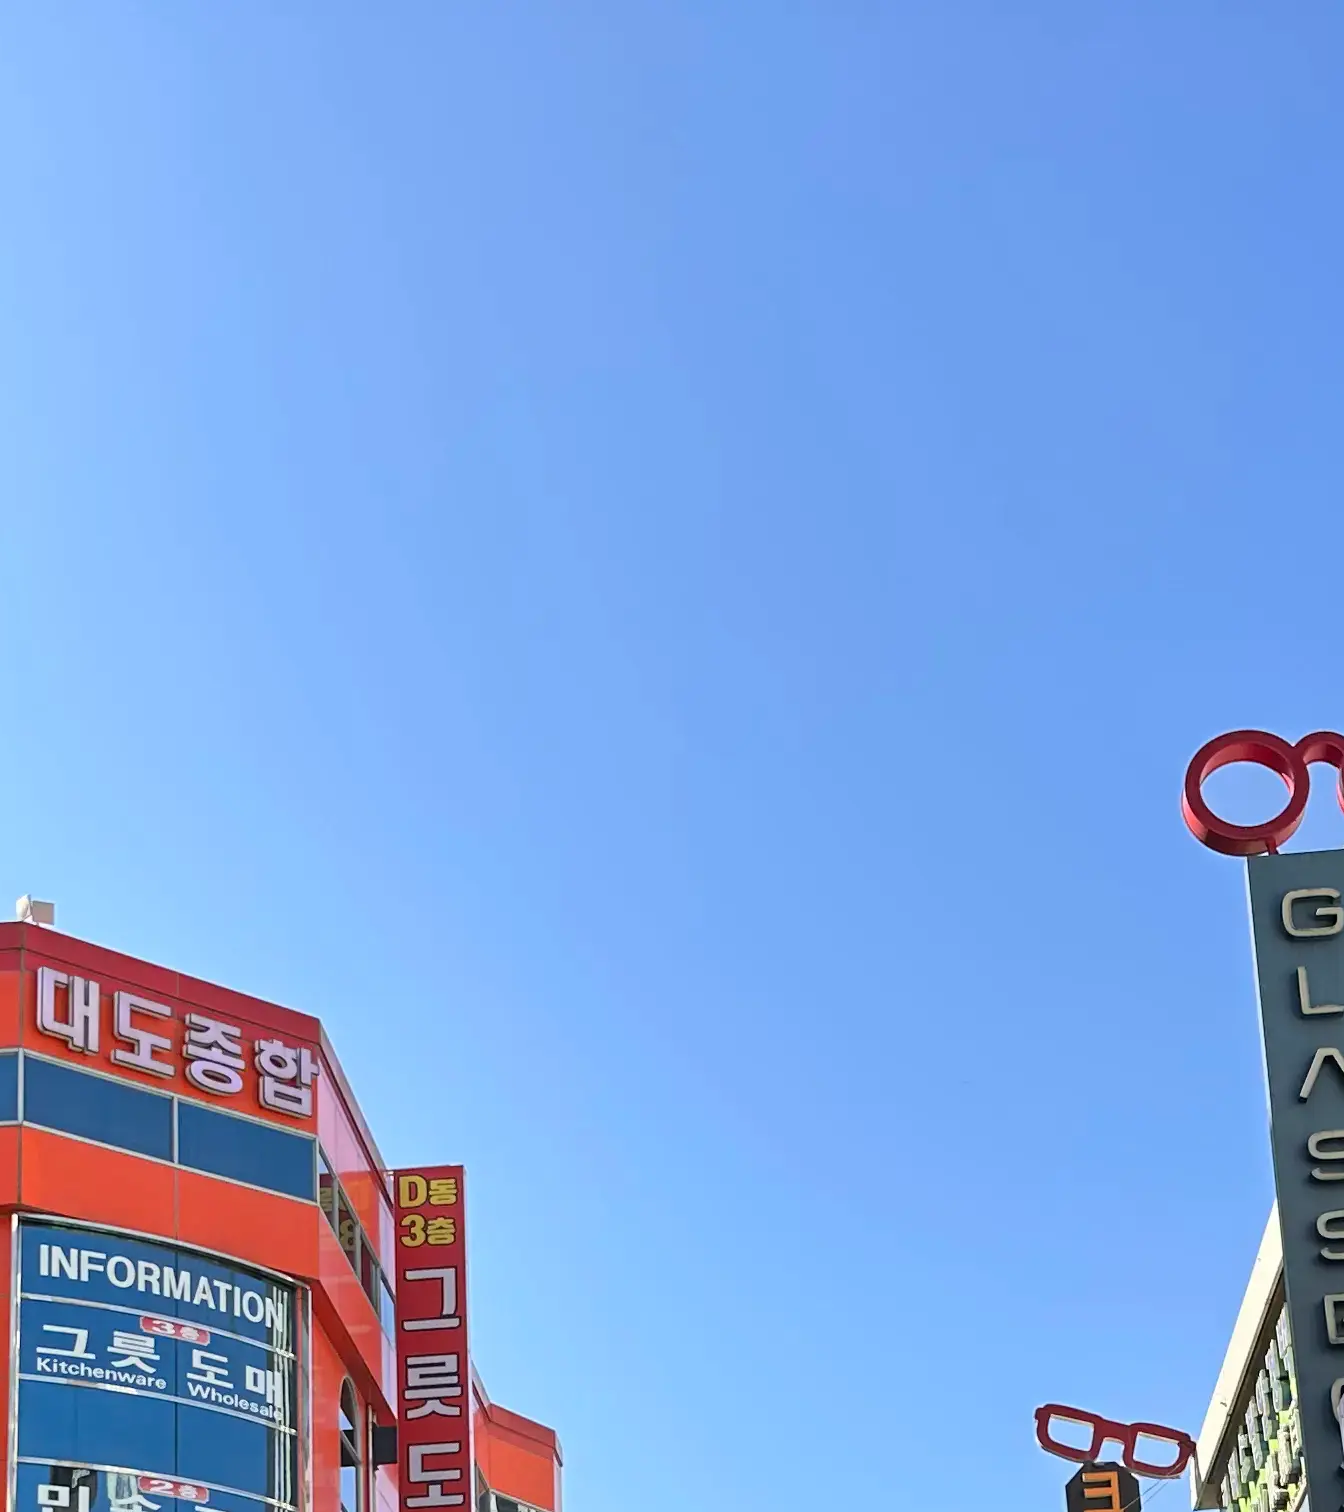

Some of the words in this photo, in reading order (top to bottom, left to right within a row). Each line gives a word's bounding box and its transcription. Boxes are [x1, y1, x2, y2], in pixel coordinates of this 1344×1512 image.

[37, 966, 320, 1119] 대도종합
[399, 1175, 457, 1208] D동
[400, 1214, 456, 1247] 3층
[40, 1244, 284, 1333] INFORMATION
[152, 1319, 199, 1341] 3층
[37, 1357, 167, 1390] Kitchenware
[187, 1382, 283, 1422] Wholesale
[149, 1480, 199, 1500] 2층
